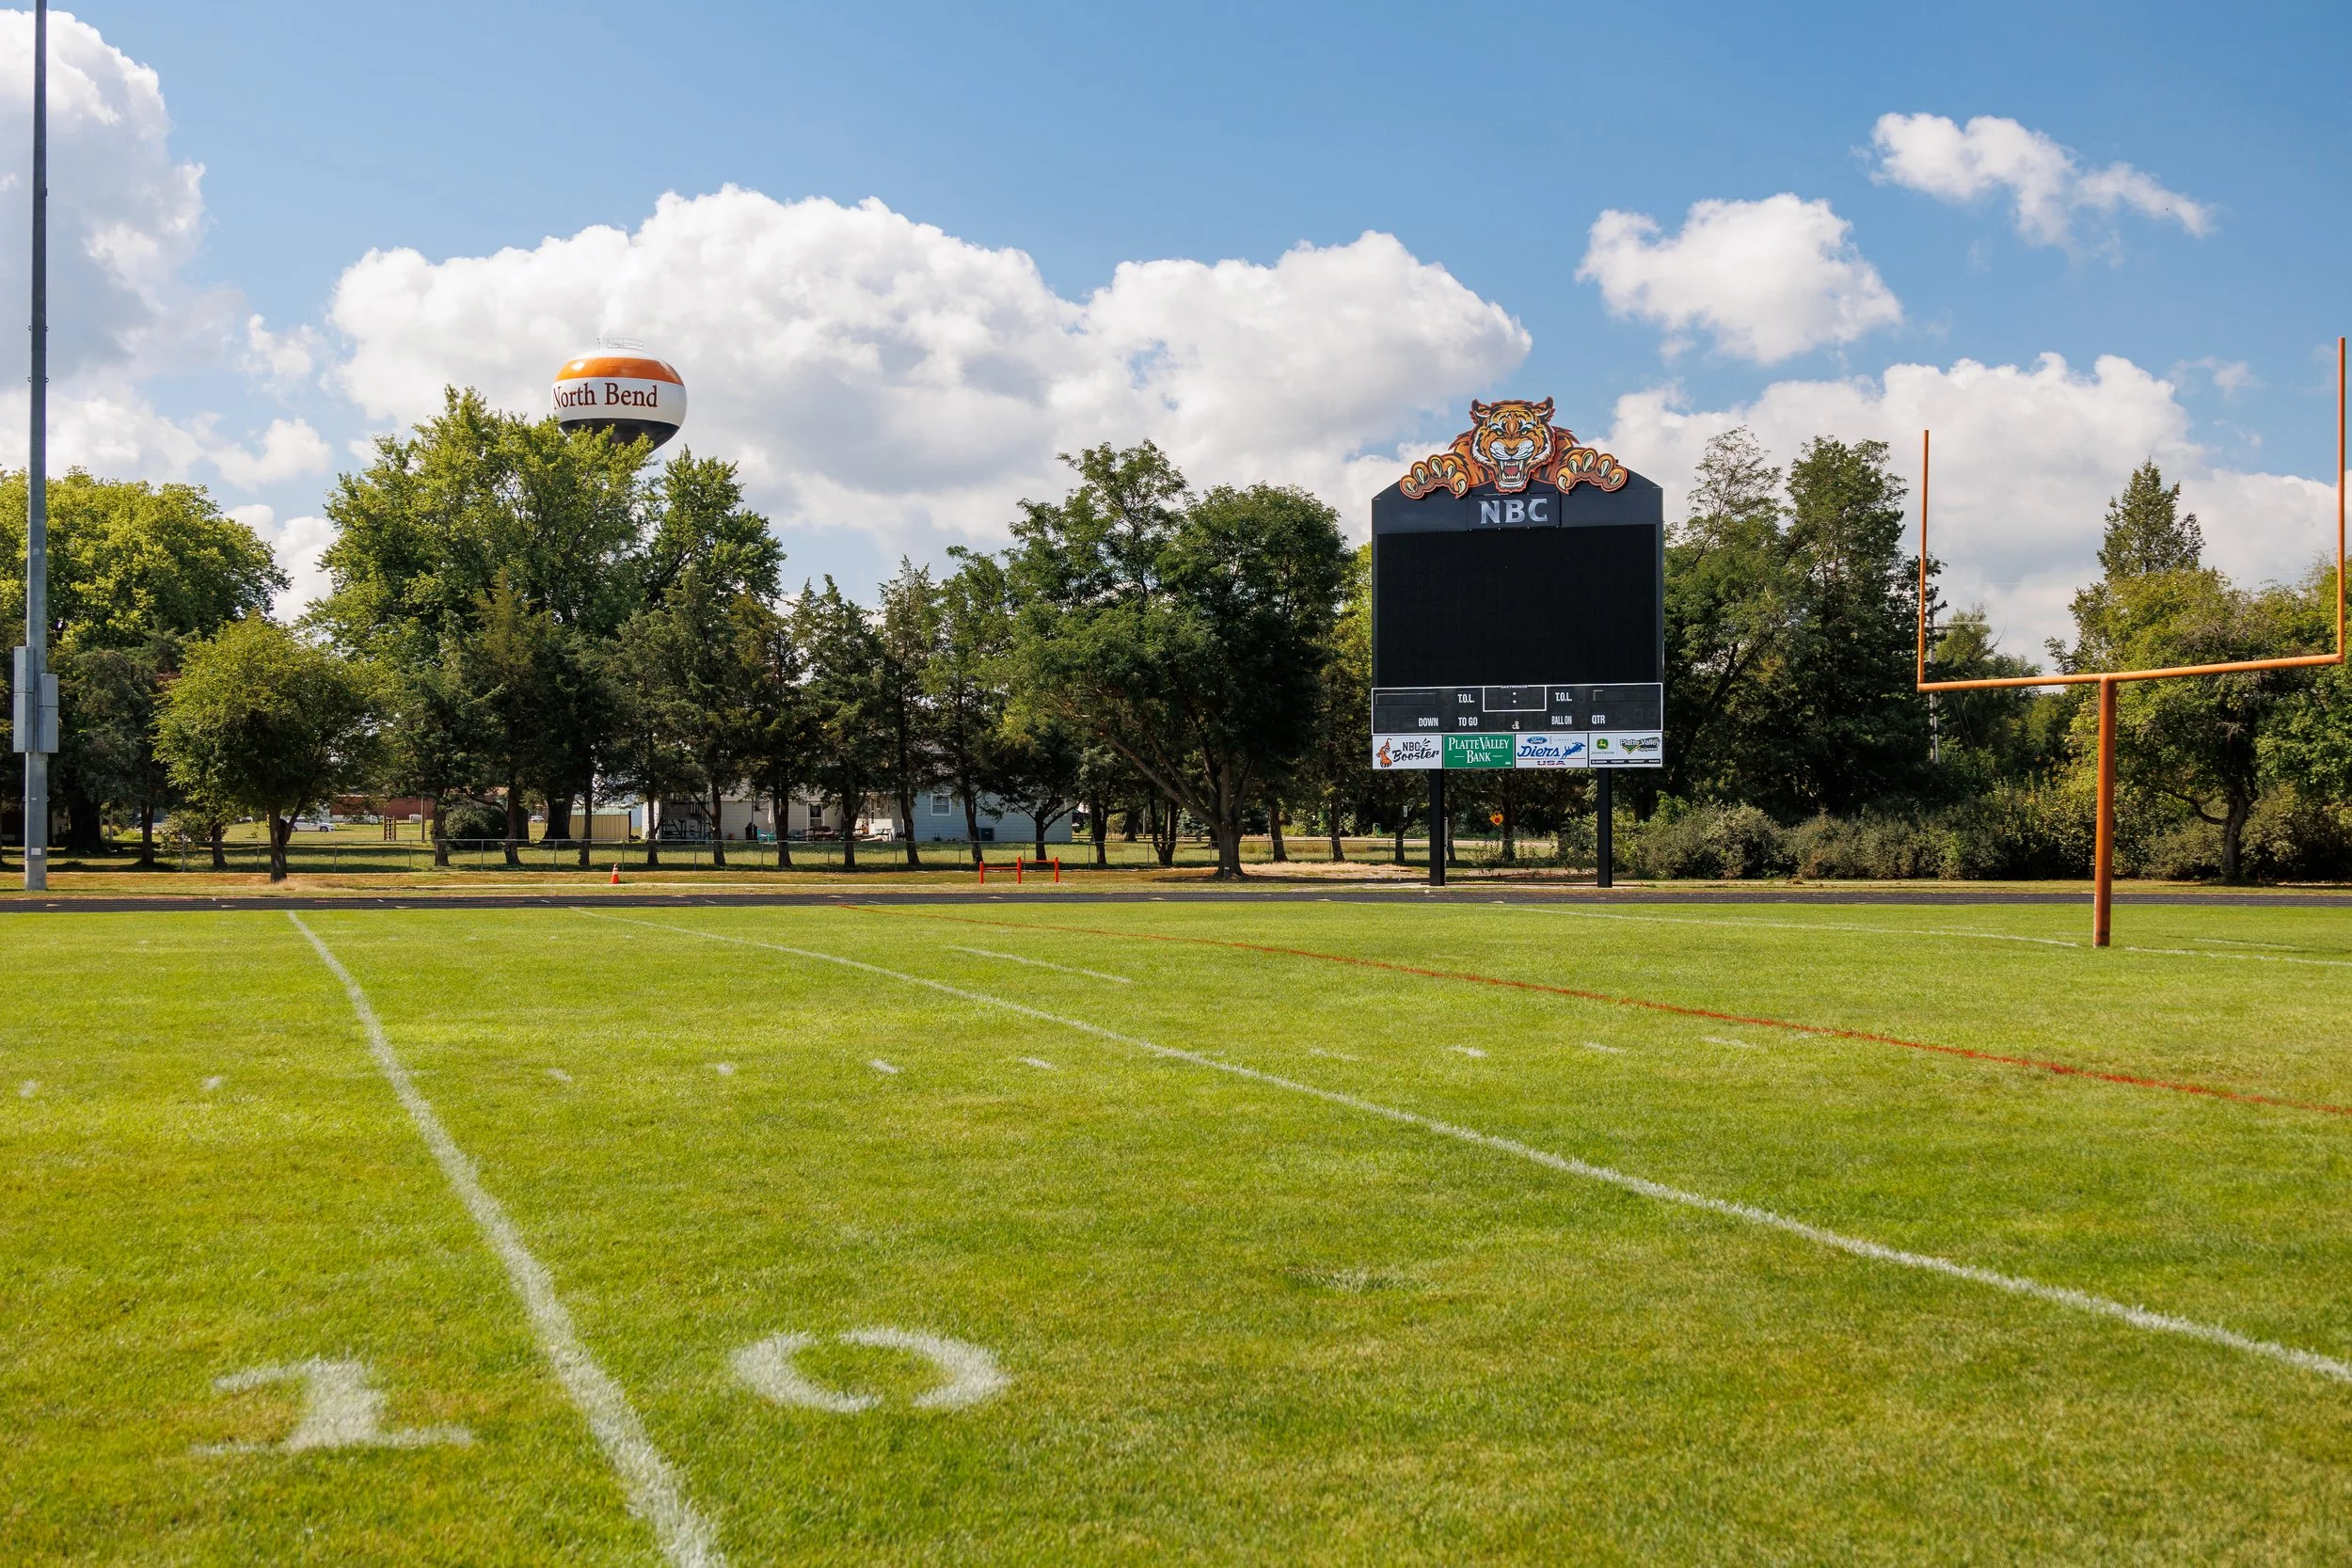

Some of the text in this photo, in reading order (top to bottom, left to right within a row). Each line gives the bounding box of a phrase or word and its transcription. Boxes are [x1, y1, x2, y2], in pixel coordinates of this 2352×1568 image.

[553, 382, 658, 409] North Bend
[1478, 498, 1548, 524] NBC
[1457, 694, 1474, 703] T.O.L.
[1555, 692, 1572, 702] T.O.L.
[1418, 718, 1438, 727] DOWN
[1458, 717, 1478, 726] TO GO
[1551, 716, 1572, 725] BALL ON
[1592, 715, 1606, 724] QTR
[1403, 742, 1420, 752] NBC
[1641, 738, 1660, 747] Valley
[1392, 748, 1439, 762] Booster
[1467, 750, 1491, 763] BANK
[1518, 746, 1560, 757] Diers
